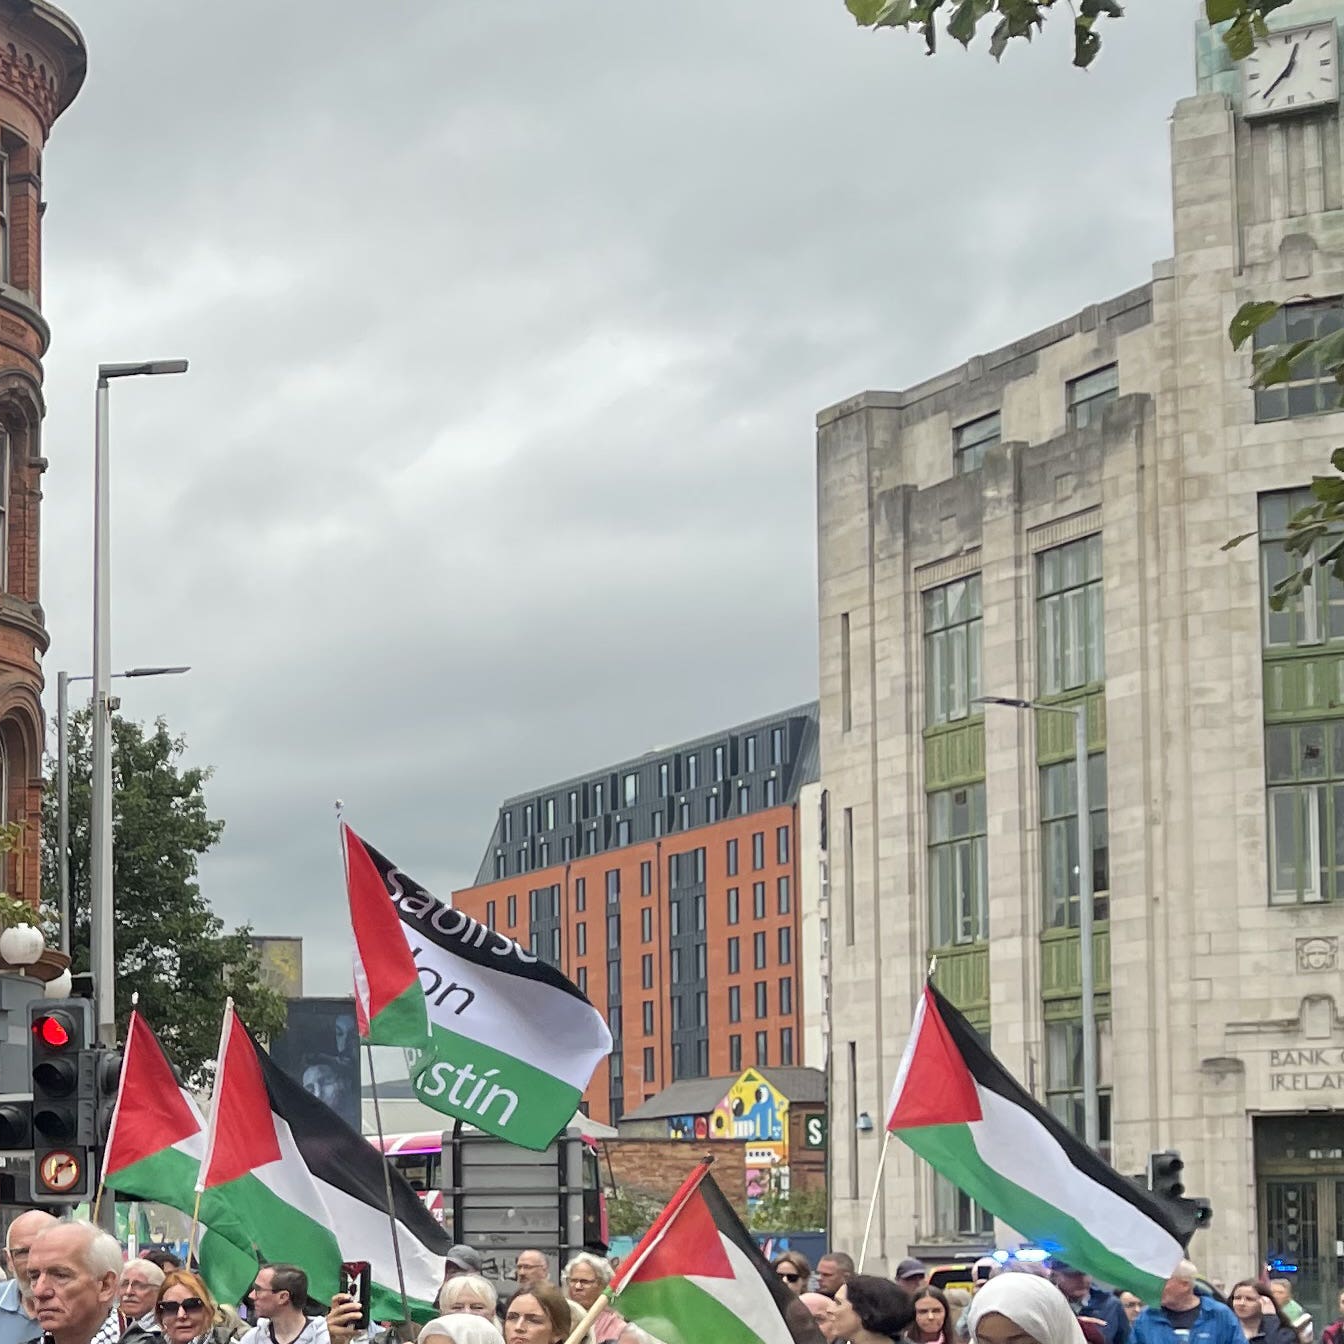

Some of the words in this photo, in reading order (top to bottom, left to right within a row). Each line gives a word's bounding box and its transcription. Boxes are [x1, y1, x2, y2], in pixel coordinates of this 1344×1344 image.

[412, 947, 475, 1016] on
[1270, 1050, 1331, 1067] BANK
[416, 1062, 519, 1127] stín
[808, 1118, 823, 1145] S
